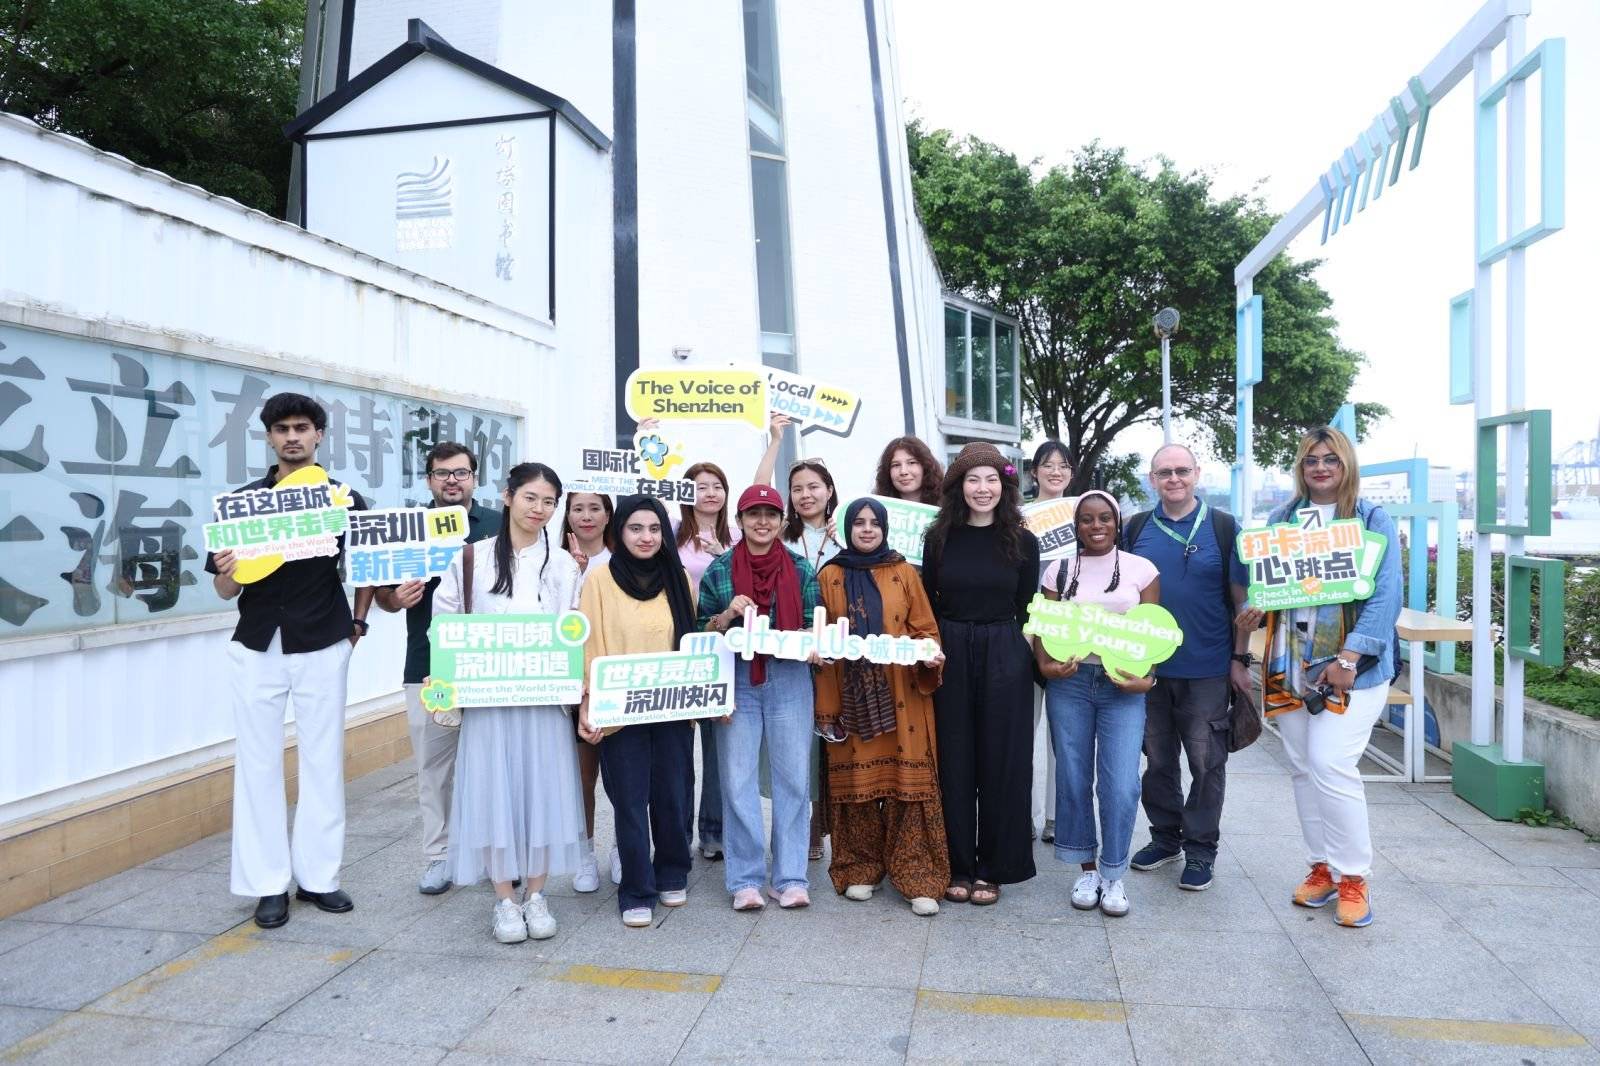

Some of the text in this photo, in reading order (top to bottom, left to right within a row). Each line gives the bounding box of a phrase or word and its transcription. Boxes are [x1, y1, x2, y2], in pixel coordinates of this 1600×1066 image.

[637, 380, 761, 395] The Voice of
[653, 399, 744, 413] Shenzhen
[583, 449, 640, 474] 国际化
[563, 481, 635, 494] WORLD AROUND
[592, 476, 635, 485] MEET THE
[636, 478, 695, 502] 在身边
[216, 485, 332, 520] 在这座城
[206, 509, 348, 549] 和世界击掌
[349, 511, 457, 546] 深圳 Hi
[1243, 524, 1361, 558] 打卡深圳
[288, 540, 305, 550] the
[297, 548, 314, 557] this
[351, 546, 461, 582] 新青年
[1255, 552, 1357, 585] 心跳点
[1254, 586, 1301, 600] Check in
[1033, 598, 1182, 645] Just Shenzhen
[437, 622, 553, 649] 世界同频
[1029, 615, 1147, 660] Just Young
[602, 657, 715, 689] 世界灵感
[458, 685, 493, 694] Where
[496, 684, 513, 693] the
[515, 683, 546, 692] World
[458, 694, 509, 705] Shenzhen
[624, 683, 728, 714] 深圳快闪
[594, 716, 621, 725] World
